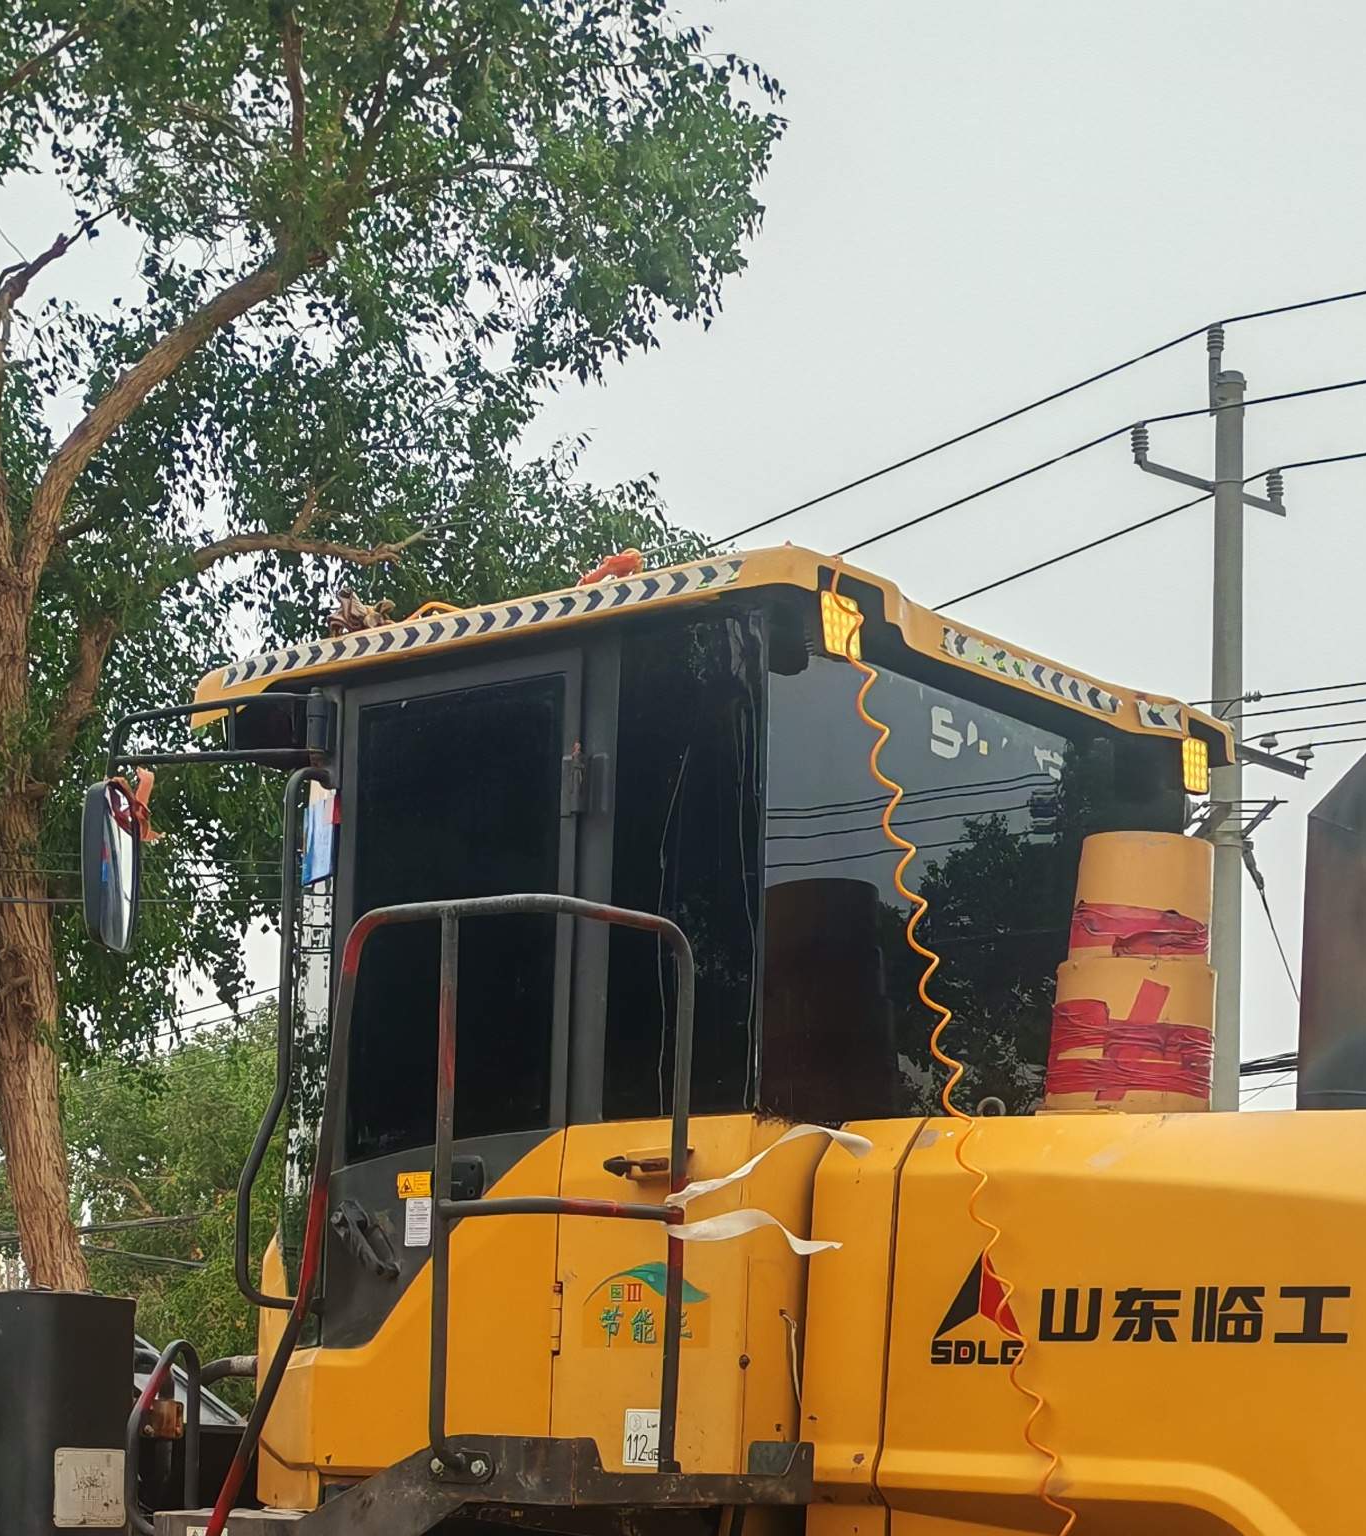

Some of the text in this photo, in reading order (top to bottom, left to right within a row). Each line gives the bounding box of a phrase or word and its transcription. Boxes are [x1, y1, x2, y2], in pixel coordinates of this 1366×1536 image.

[1038, 1286, 1351, 1343] 山东临工
[931, 1340, 1023, 1365] SDLG
